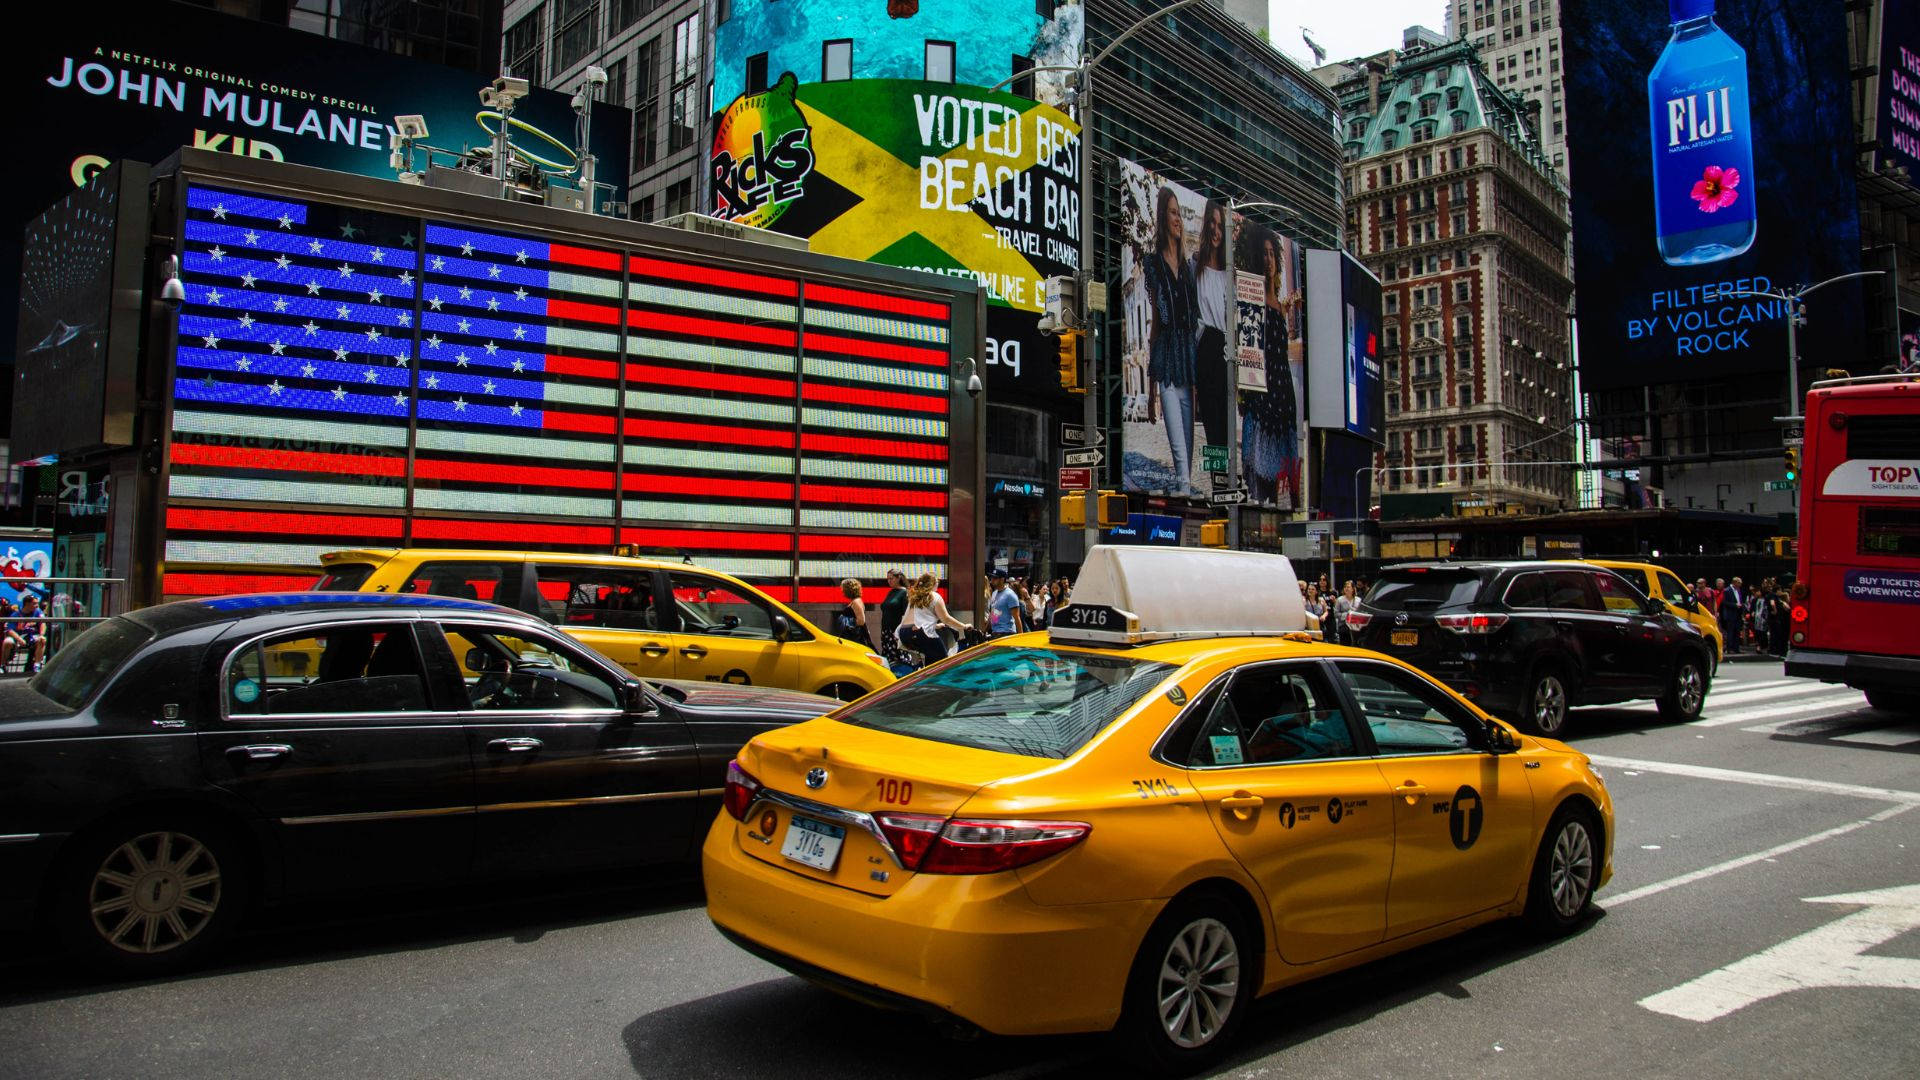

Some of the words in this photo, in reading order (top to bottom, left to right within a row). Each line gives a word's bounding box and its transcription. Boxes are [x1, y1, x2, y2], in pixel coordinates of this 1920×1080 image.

[46, 56, 186, 112] JOHN
[95, 47, 103, 56] A
[111, 50, 177, 72] NETFLIX
[184, 66, 254, 88] ORIGINAL
[261, 82, 316, 102] COMEDY
[322, 95, 377, 114] SPECIAL
[1666, 87, 1733, 146] FIJI
[913, 94, 1022, 158] VOTED
[1036, 115, 1081, 184] BEST
[1668, 143, 1691, 154] NATURAL
[1691, 139, 1716, 149] ARTESIAN
[1717, 134, 1734, 143] WATER
[919, 155, 1032, 223] BEACH
[1044, 176, 1080, 242] BAR
[1046, 238, 1080, 272] CHANNEL
[1652, 276, 1771, 311] FILTERED
[1628, 316, 1659, 340] BY
[1677, 328, 1750, 356] ROCK
[1068, 430, 1081, 439] ONE
[1070, 454, 1082, 464] ONE
[1086, 452, 1100, 462] WAY
[1203, 446, 1227, 458] Broadway
[1204, 460, 1210, 469] W
[1212, 460, 1220, 469] 43
[1004, 483, 1024, 494] Nasdaq
[1871, 483, 1919, 491] SIGHTSEEING
[1118, 528, 1137, 536] Nasdaq
[1159, 528, 1176, 541] Nasdaq
[1858, 576, 1878, 585] BUY
[1071, 608, 1108, 625] 3Y16
[876, 777, 913, 806] 100
[1132, 777, 1180, 799] 3Y16
[1432, 801, 1450, 814] NYC
